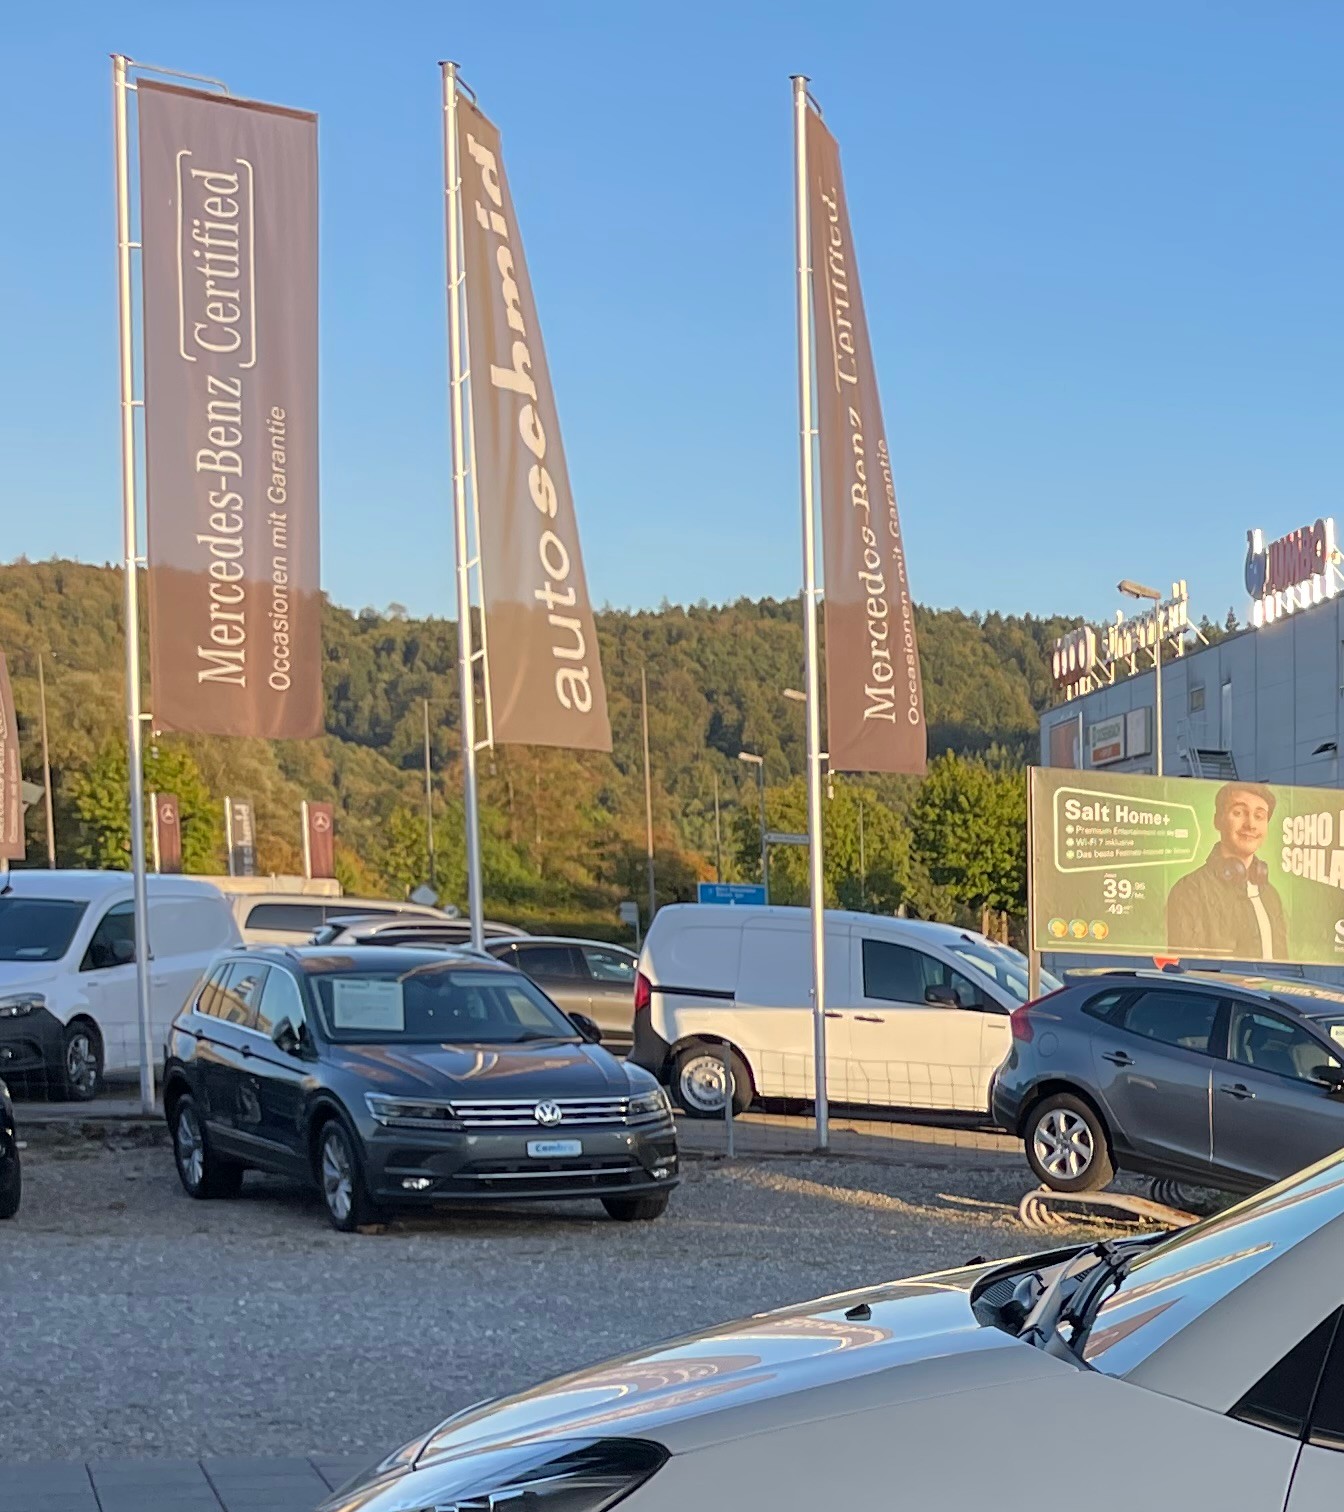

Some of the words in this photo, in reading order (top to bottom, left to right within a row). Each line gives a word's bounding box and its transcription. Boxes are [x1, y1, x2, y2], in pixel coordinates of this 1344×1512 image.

[191, 168, 243, 354] Certified
[267, 405, 288, 505] Garantie
[195, 374, 247, 689] Mercedes-Benz
[267, 511, 288, 546] mit
[268, 552, 292, 692] Occasionen
[1065, 799, 1110, 822] Salt
[1115, 805, 1171, 826] Home+
[1282, 811, 1333, 847] SCHO
[1103, 878, 1132, 899] 39
